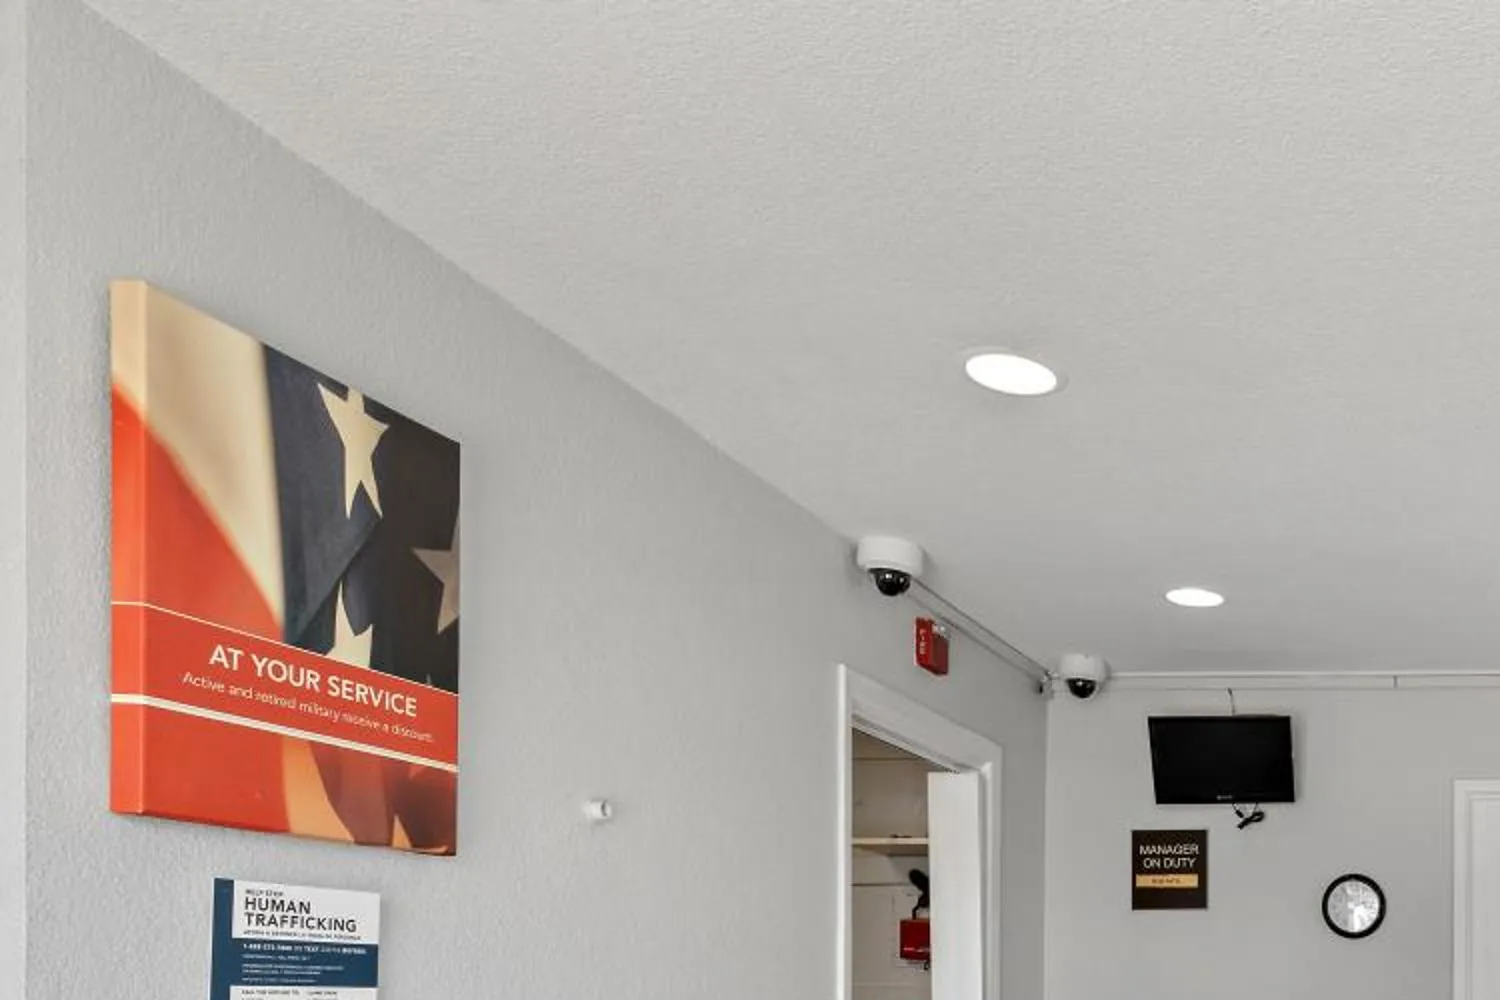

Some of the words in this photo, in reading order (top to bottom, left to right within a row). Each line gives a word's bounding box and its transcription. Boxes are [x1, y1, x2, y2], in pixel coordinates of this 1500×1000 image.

[208, 644, 245, 672] AT
[251, 653, 321, 693] YOUR
[327, 675, 418, 717] SERVICE
[183, 671, 225, 694] Active
[229, 684, 254, 700] and
[299, 702, 341, 722] military
[1139, 844, 1199, 855] MANAGER
[1143, 857, 1161, 869] ON
[1163, 857, 1196, 869] DUTY
[244, 896, 312, 915] HUMAN
[244, 912, 358, 933] TRAFFICKING
